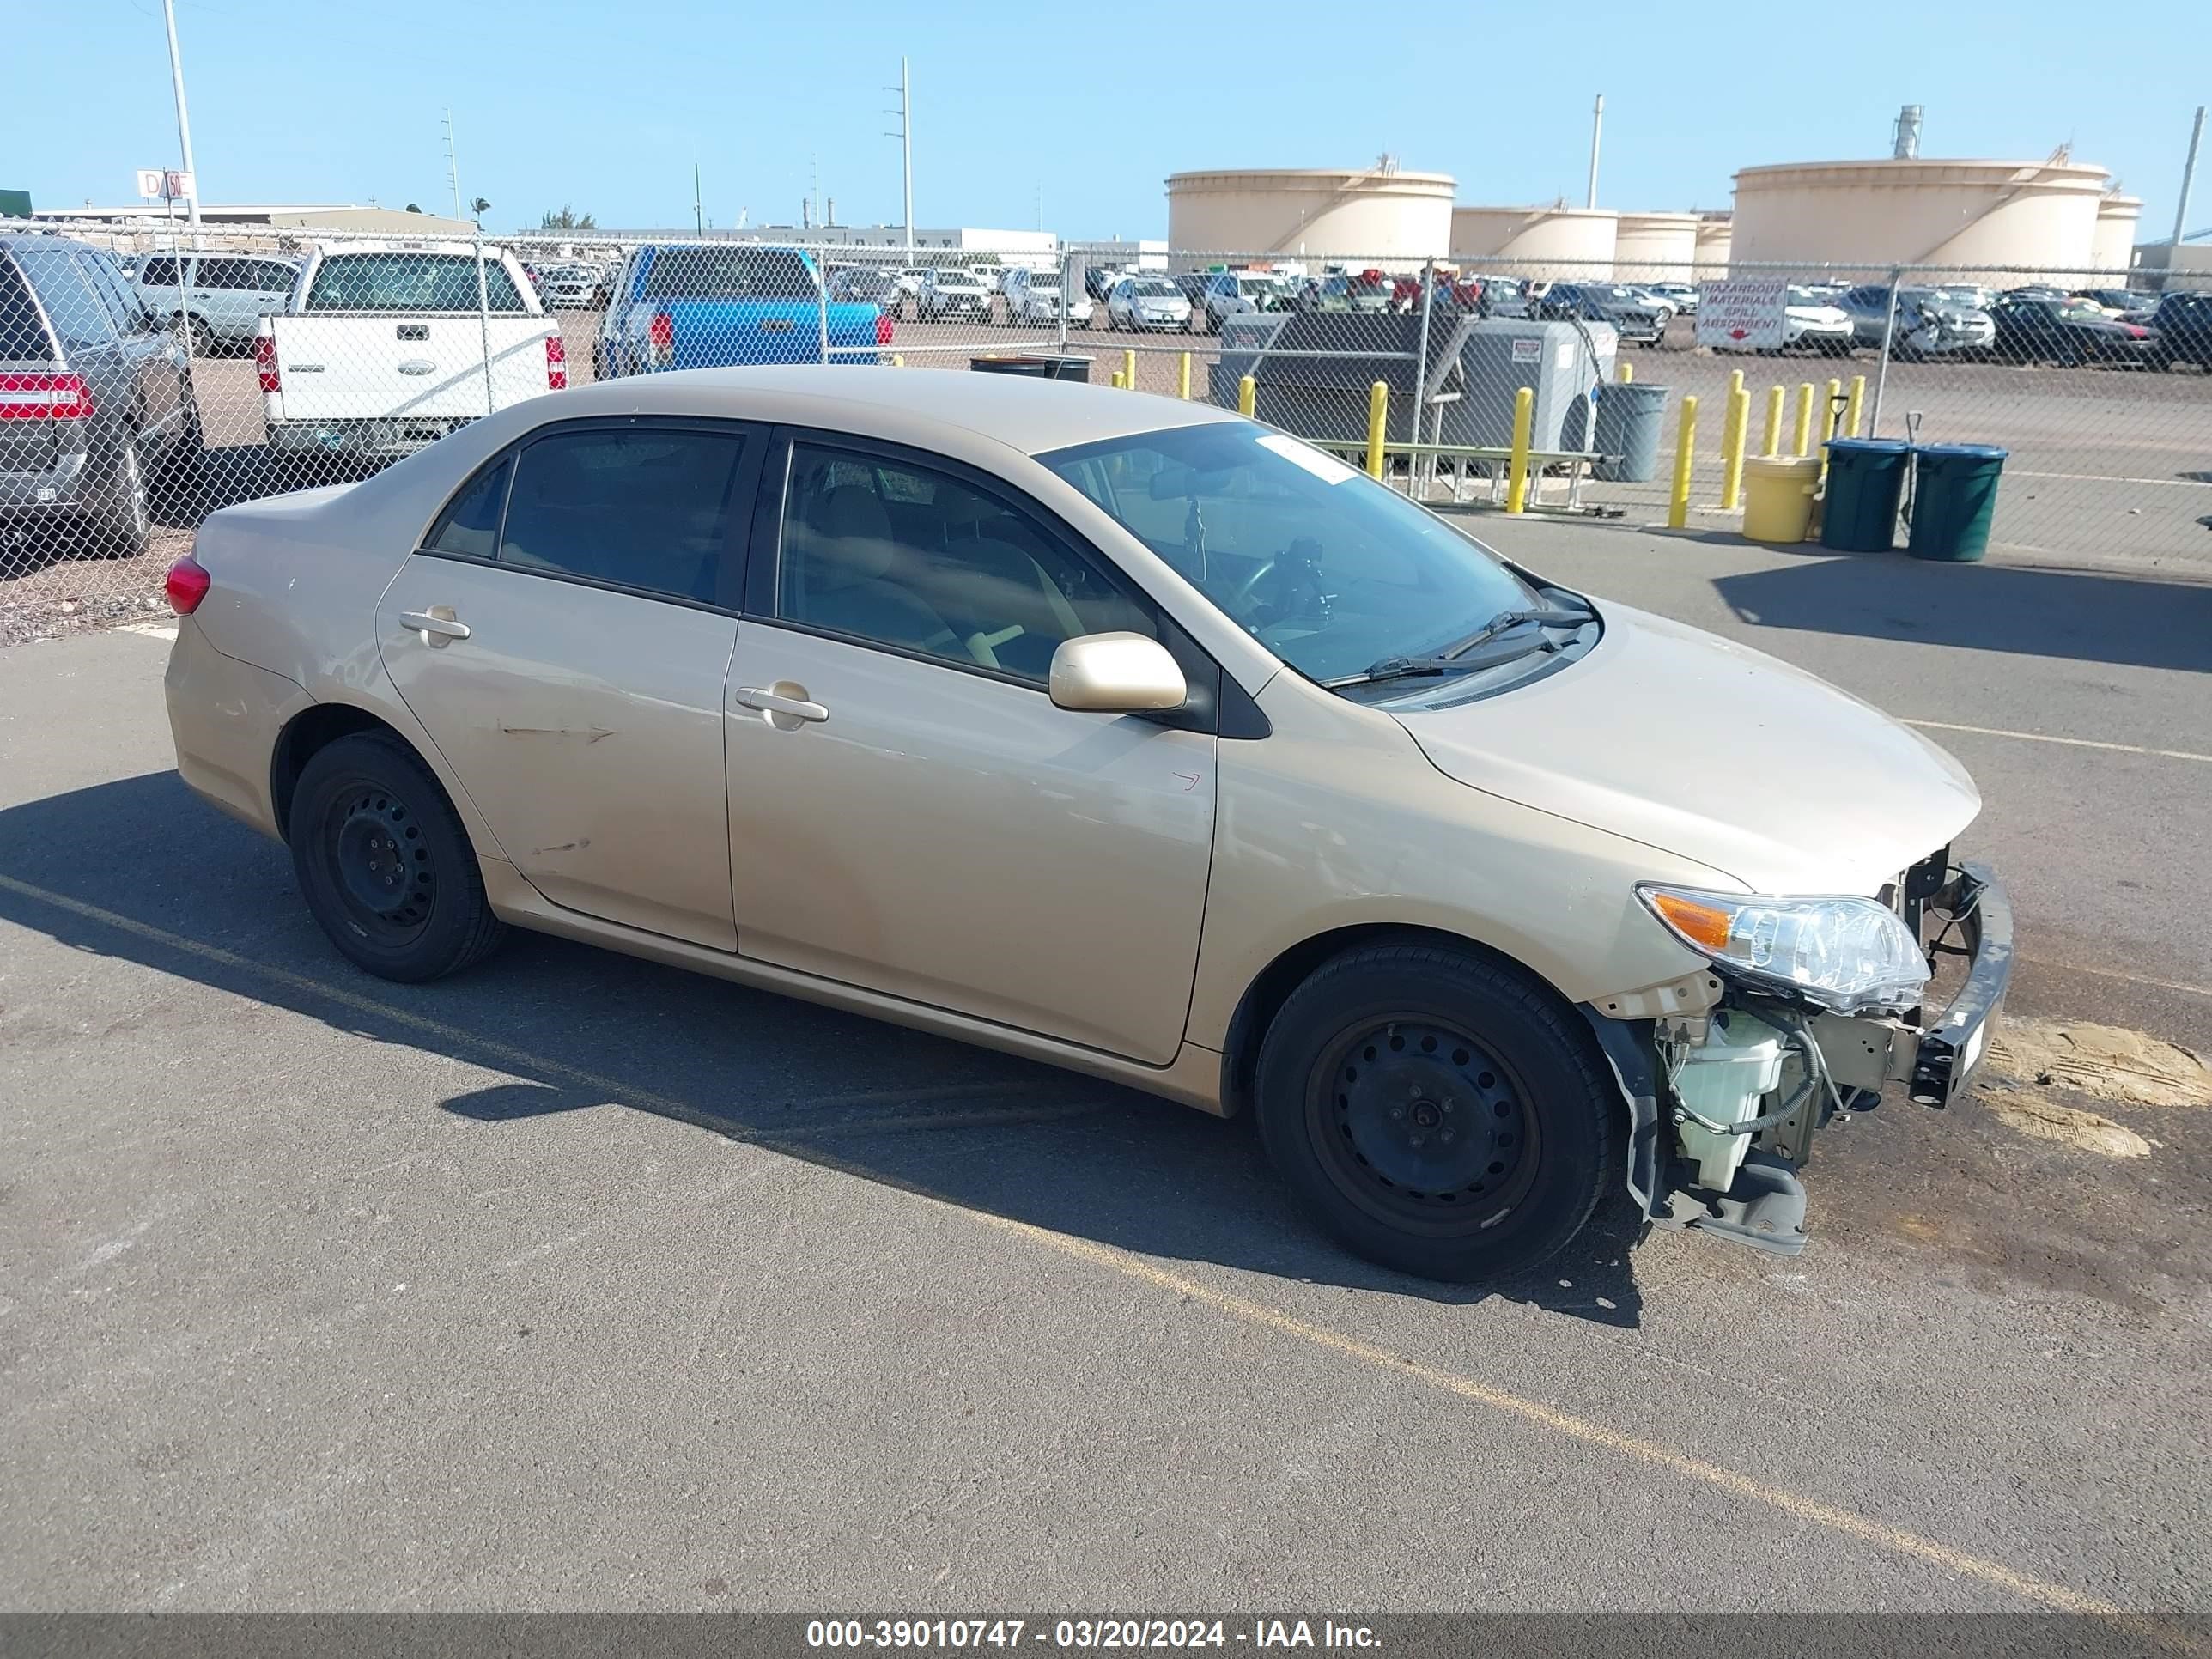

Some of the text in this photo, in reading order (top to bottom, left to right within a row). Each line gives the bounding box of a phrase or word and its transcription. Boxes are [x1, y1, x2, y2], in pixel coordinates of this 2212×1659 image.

[1705, 283, 1783, 294] HAZARDOUS
[1707, 295, 1778, 305] MATERIALS
[1724, 307, 1759, 317] SPILL
[1701, 319, 1778, 328] ABSORBENT
